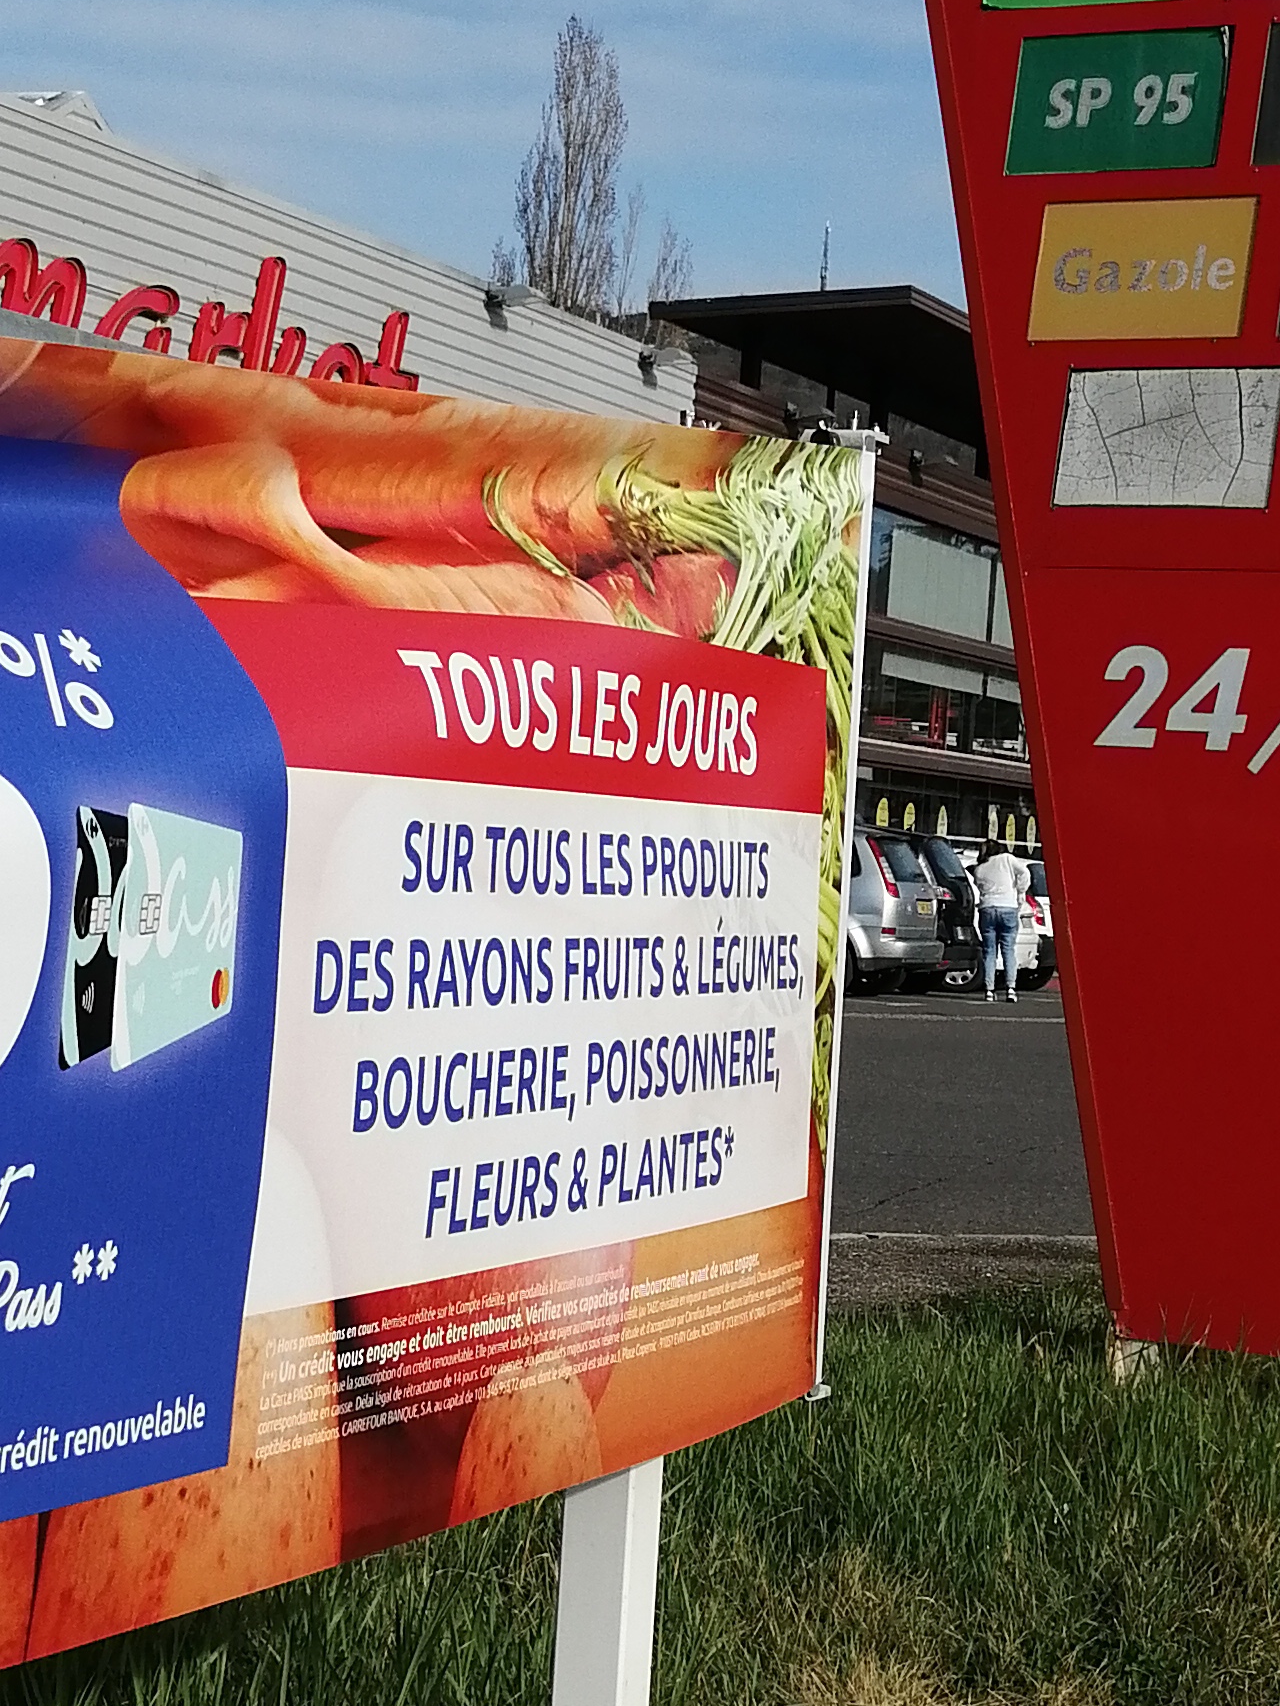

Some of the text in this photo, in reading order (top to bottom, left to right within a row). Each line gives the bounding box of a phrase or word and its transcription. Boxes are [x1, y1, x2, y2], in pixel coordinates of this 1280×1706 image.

[1044, 71, 1199, 129] SP 95
[1053, 243, 1236, 295] Gazole
[397, 648, 759, 776] TOUS LES JOURS
[401, 820, 770, 900] SUR TOUS LES PRODUITS
[313, 917, 805, 1014] DES RAYONS FRUITS & LÉGUMES,
[352, 1026, 781, 1133] BOUCHERIE, POISSONNERIE,
[424, 1149, 561, 1240] FLEURS
[569, 1150, 588, 1213] &
[278, 1339, 297, 1353] Hors
[298, 1328, 345, 1351] promotions
[346, 1327, 356, 1338] en
[357, 1322, 380, 1336] cours.
[407, 1306, 436, 1325] créditée
[456, 1300, 480, 1315] Compte
[280, 1361, 295, 1381] Un
[298, 1350, 334, 1378] crédit
[337, 1349, 363, 1369] vous
[366, 1339, 406, 1363] engage
[408, 1334, 420, 1353] et
[422, 1326, 444, 1349] doit
[446, 1323, 467, 1344] être
[469, 1308, 524, 1338] remboursé.
[525, 1300, 560, 1325] Vérifiez
[562, 1299, 577, 1316] vos
[580, 1285, 617, 1313] capacités
[620, 1283, 629, 1302] de
[630, 1270, 688, 1299] remboursement
[690, 1264, 708, 1284] avant
[710, 1261, 718, 1278] de
[719, 1259, 734, 1276] vous
[734, 1253, 760, 1274] engager.
[258, 1410, 318, 1434] correspondante
[320, 1407, 330, 1419] en
[355, 1393, 372, 1411] Délai
[375, 1389, 392, 1407] légal
[392, 1388, 402, 1401] de
[402, 1377, 441, 1399] rétractation
[442, 1375, 452, 1388] de
[480, 1365, 496, 1378] Carte
[260, 1396, 270, 1410] La
[271, 1393, 292, 1408] Carte
[292, 1385, 313, 1403] PASS
[354, 1366, 396, 1388] souscription
[396, 1364, 410, 1378] d'un
[412, 1357, 430, 1374] crédit
[475, 1344, 486, 1358] Elle
[510, 1337, 521, 1349] lors
[62, 1394, 208, 1459] renouvelable
[254, 1439, 290, 1459] ceptibles
[292, 1435, 302, 1449] de
[341, 1413, 386, 1437] CARREFOUR
[387, 1405, 419, 1425] BANQUE,
[442, 1392, 464, 1411] capital
[464, 1391, 473, 1404] de
